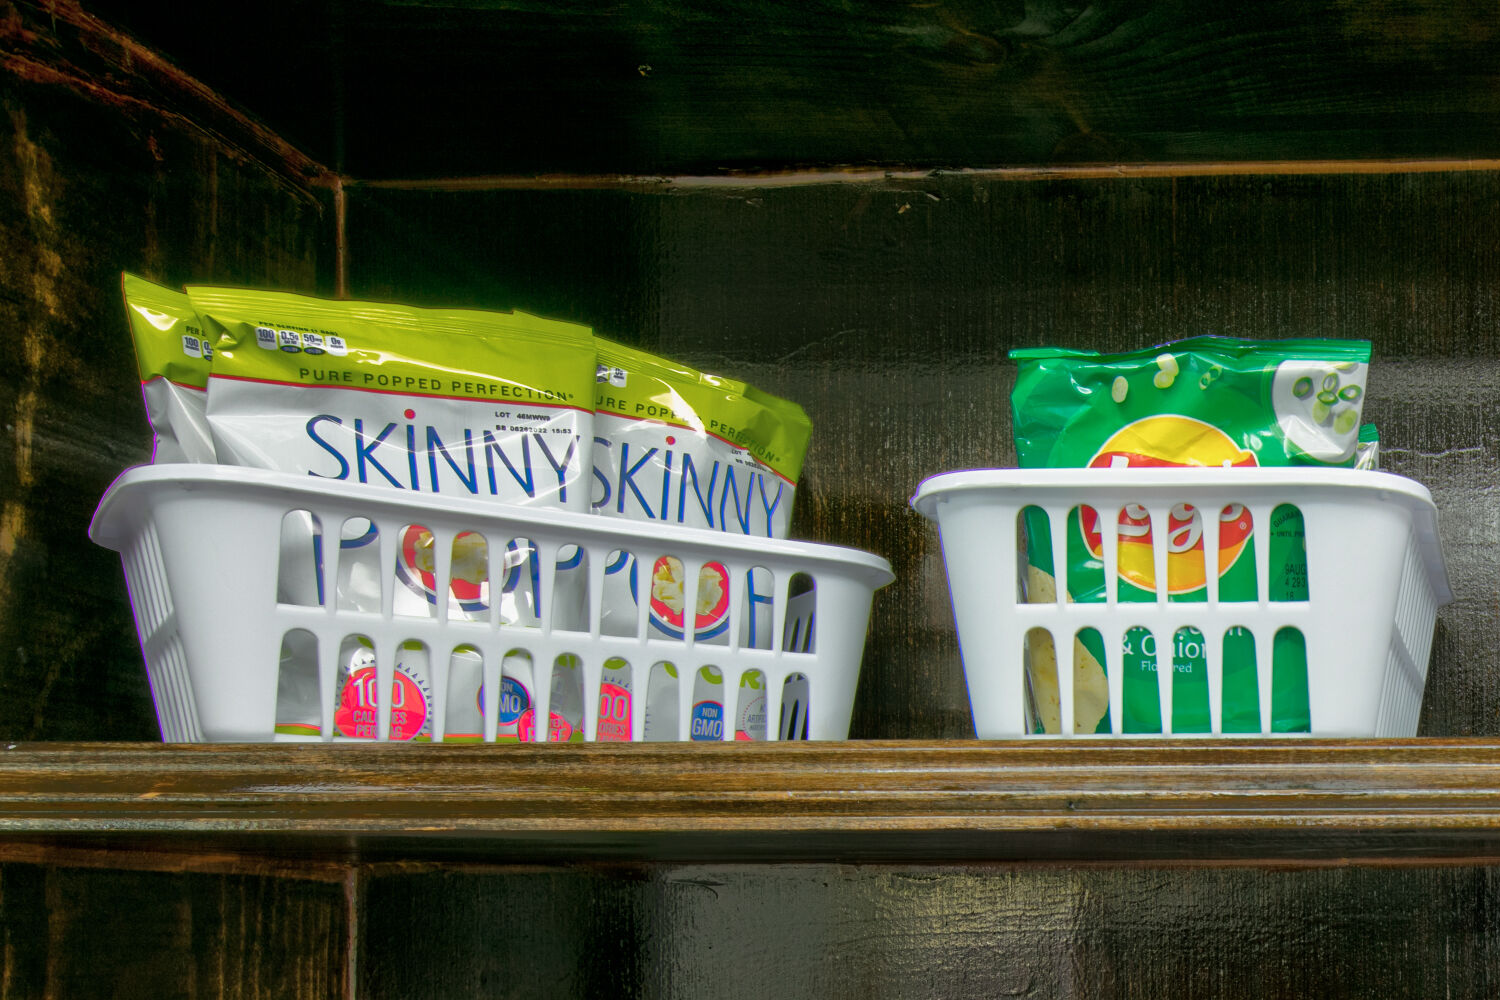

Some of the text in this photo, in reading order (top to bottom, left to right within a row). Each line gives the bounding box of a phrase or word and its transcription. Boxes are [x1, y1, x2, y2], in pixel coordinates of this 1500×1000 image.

[258, 328, 275, 339] 100
[299, 367, 570, 401] PURE POPPED PERFECTION
[595, 395, 627, 411] URE
[1141, 660, 1192, 673] Flared
[702, 707, 718, 718] NON
[692, 718, 723, 738] GMO
